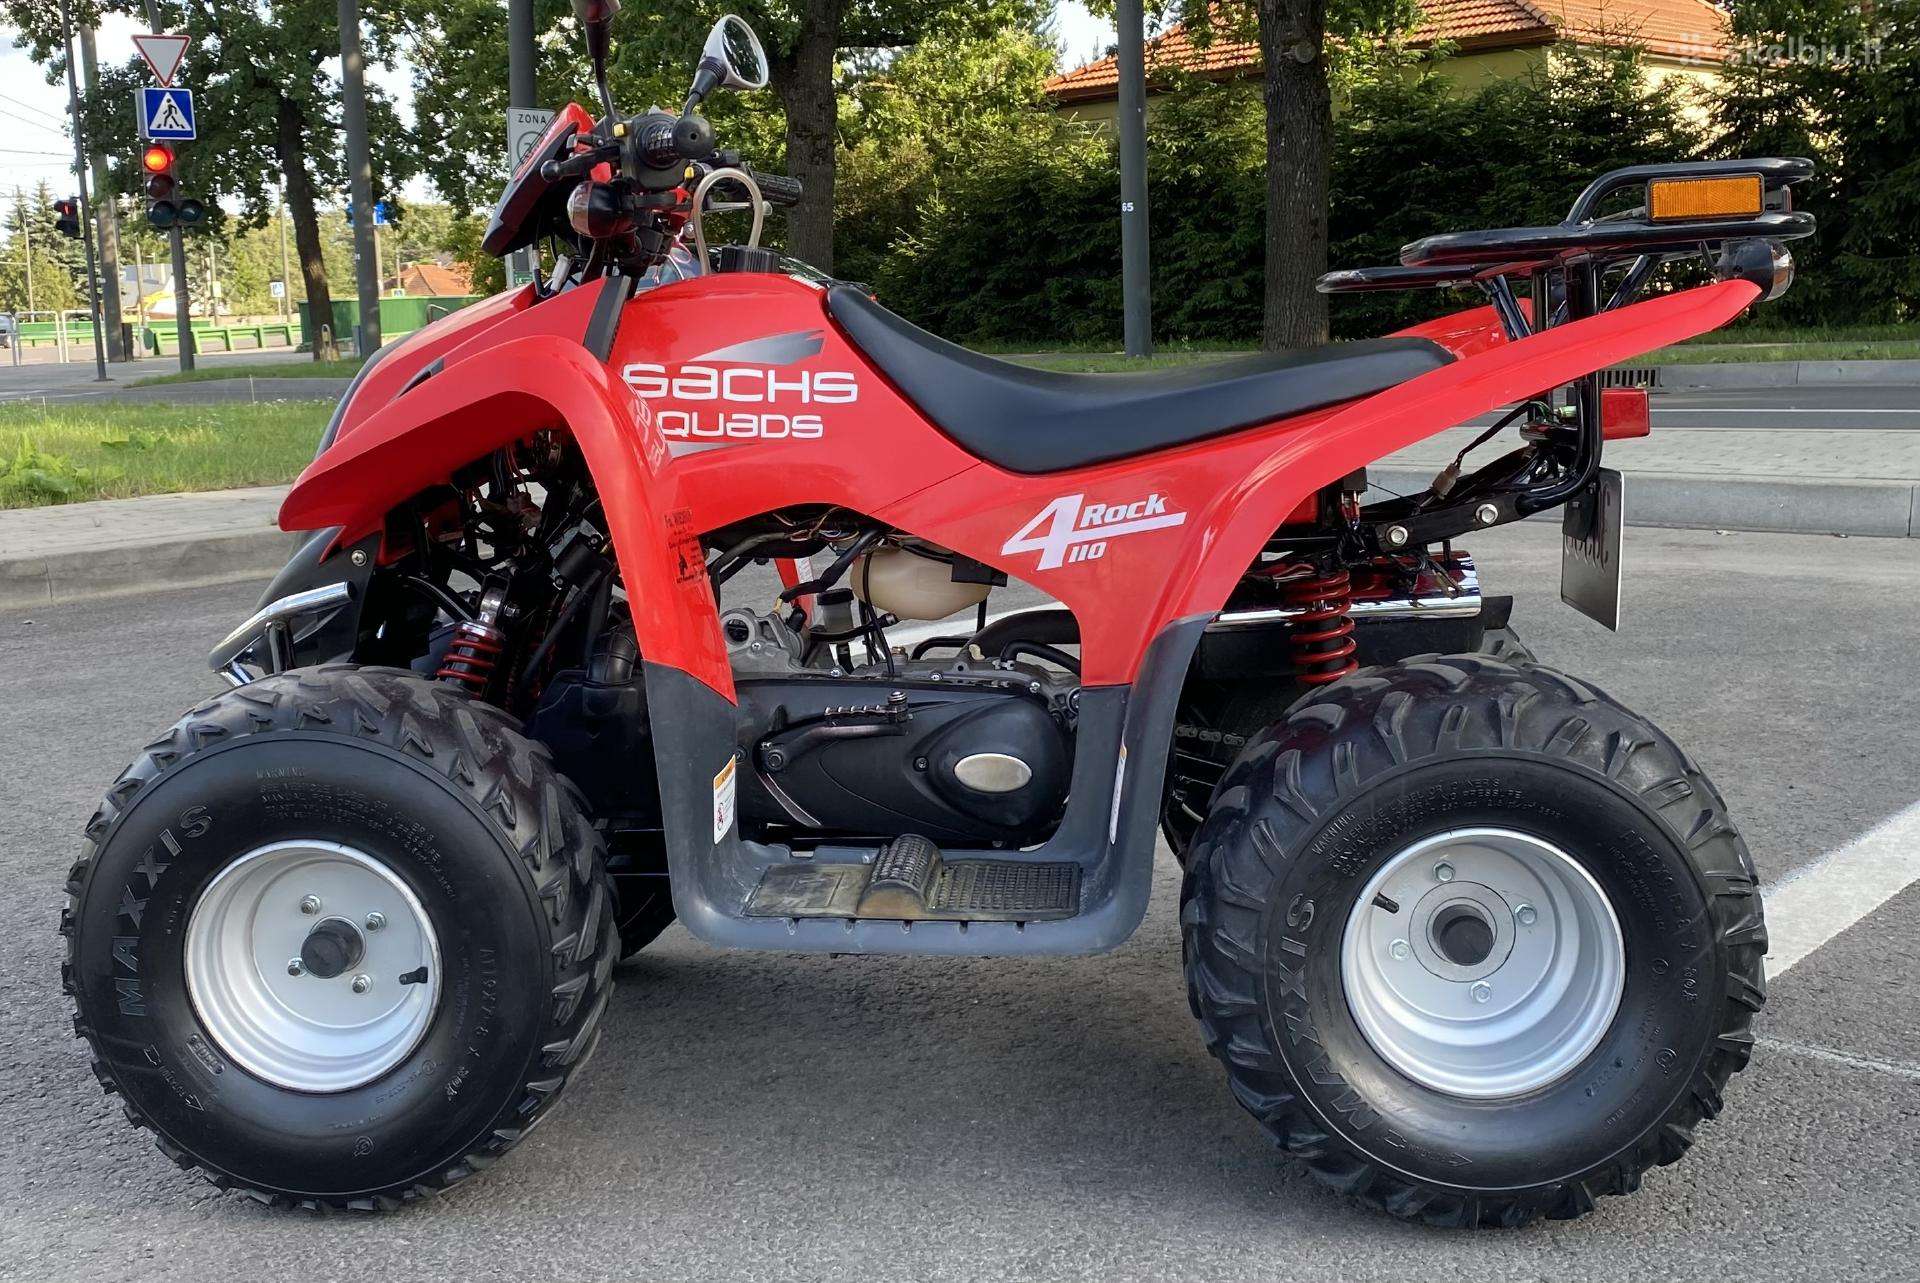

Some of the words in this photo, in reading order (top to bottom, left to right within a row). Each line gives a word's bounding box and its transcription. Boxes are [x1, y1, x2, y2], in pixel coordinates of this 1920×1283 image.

[518, 113, 547, 125] ZONA
[1121, 202, 1134, 212] 65
[1001, 493, 1086, 571] 4
[1068, 541, 1107, 563] 110
[111, 806, 213, 1017] MAXXIS
[1279, 893, 1382, 1131] MAXXIS
